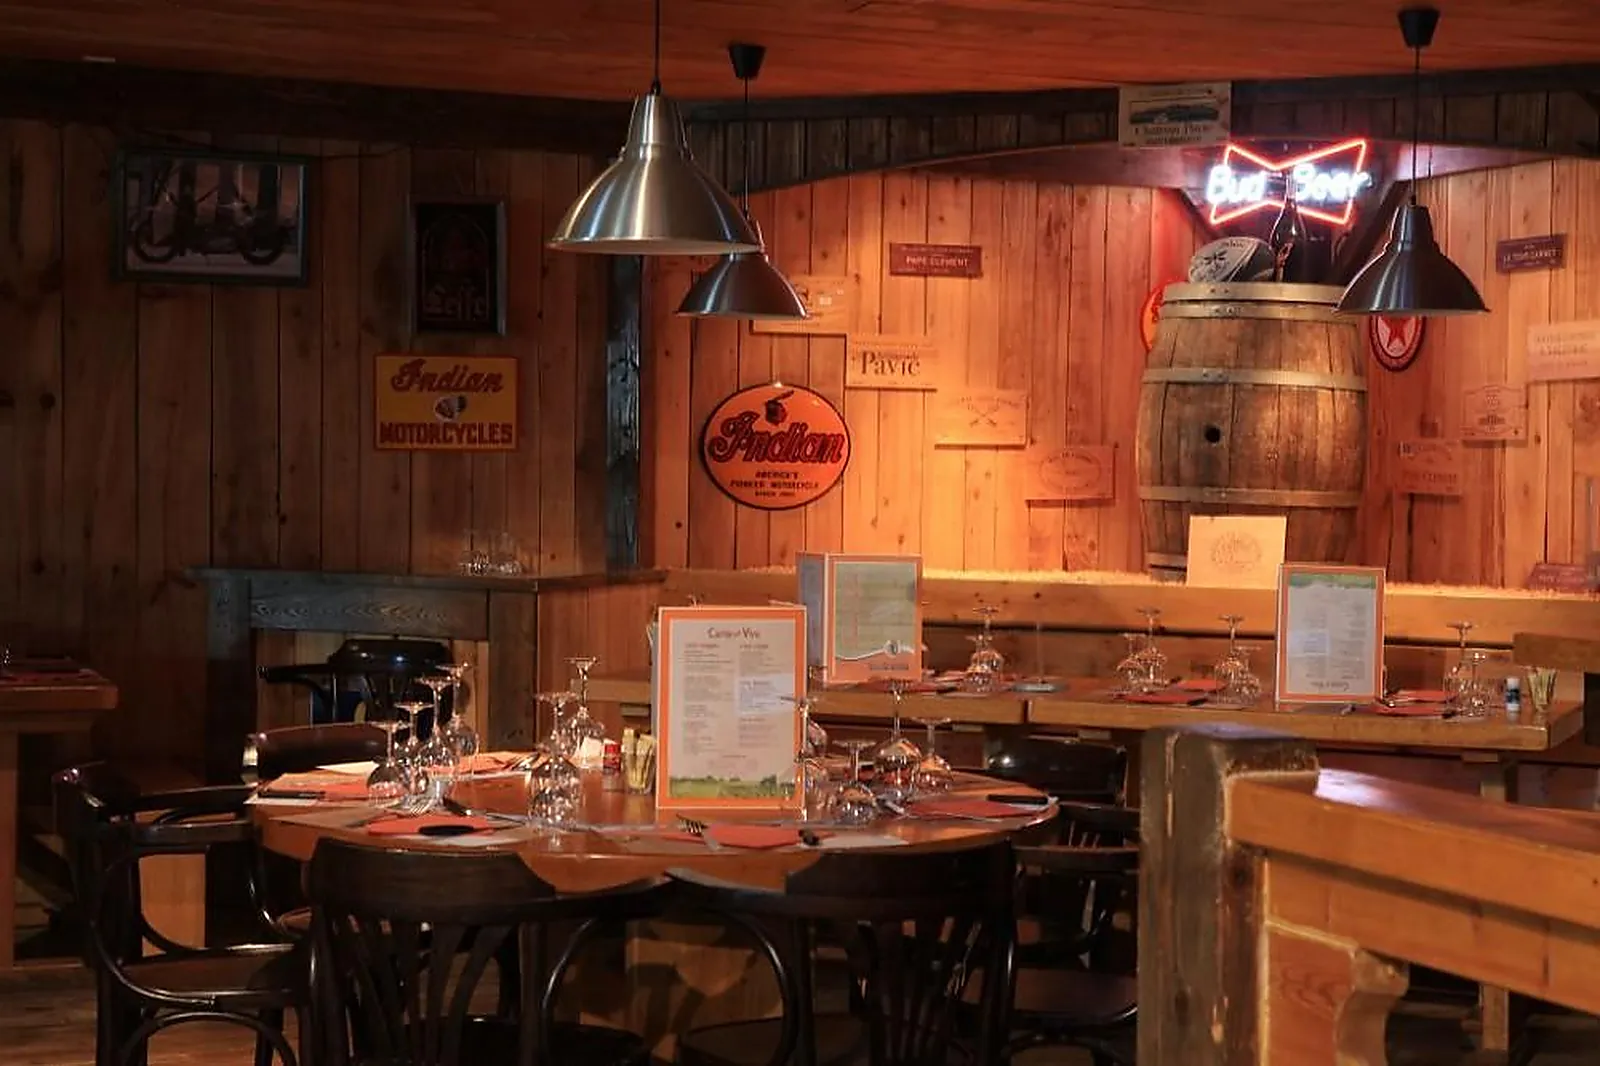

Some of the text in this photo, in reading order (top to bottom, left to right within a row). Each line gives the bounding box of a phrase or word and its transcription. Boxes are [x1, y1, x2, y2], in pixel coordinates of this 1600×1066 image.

[1207, 164, 1267, 205] Bud
[391, 358, 503, 393] Indian
[379, 422, 513, 445] MOTORCYCLES
[708, 411, 845, 464] Indian
